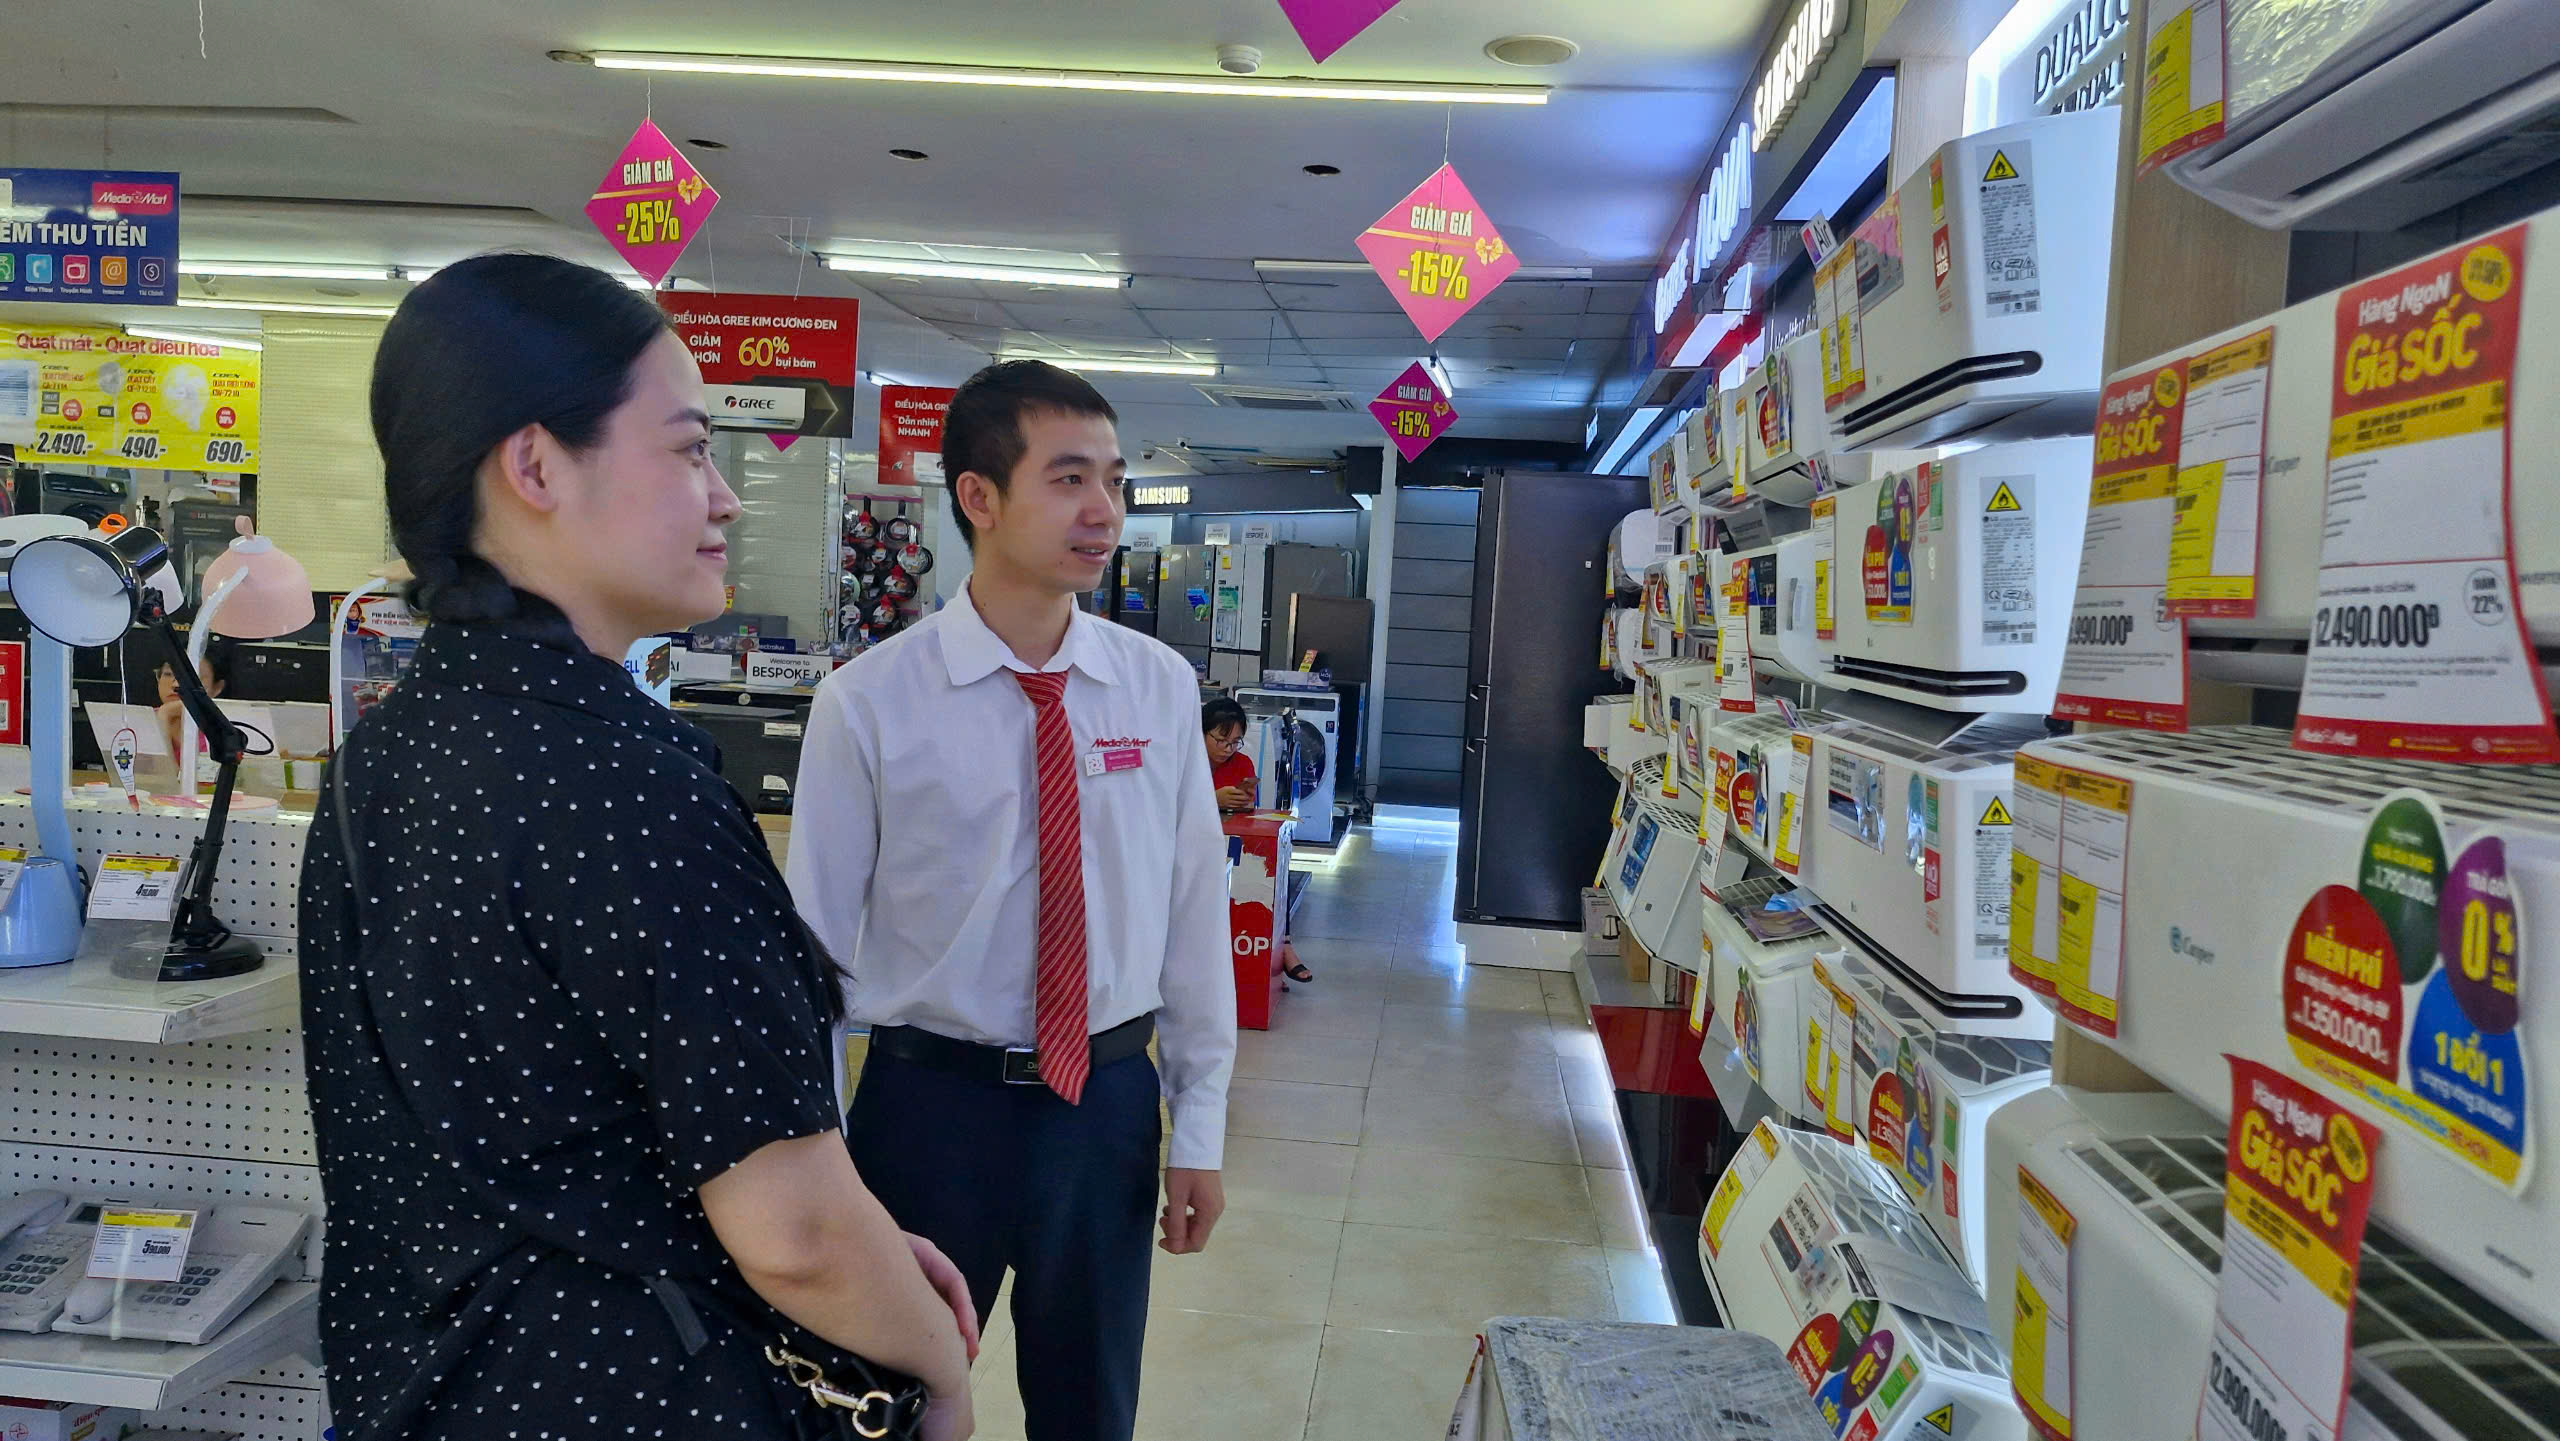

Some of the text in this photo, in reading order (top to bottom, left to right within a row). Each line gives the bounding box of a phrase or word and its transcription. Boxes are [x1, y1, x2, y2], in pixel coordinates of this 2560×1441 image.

[623, 156, 674, 185] GIẢM GIÁ
[616, 200, 680, 244] -25%
[1411, 202, 1472, 237] GIẢM GIÁ
[36, 222, 88, 246] THU
[91, 218, 148, 247] TIỀN
[1397, 250, 1469, 300] -15%
[673, 310, 837, 330] ĐIỀU HÒA GREE KIM CƯƠNG ĐEN
[689, 331, 721, 348] GIẢM
[738, 336, 790, 367] 60%
[775, 356, 816, 369] bụi bám
[2344, 333, 2398, 396] Giá
[739, 398, 776, 410] GREE
[1397, 382, 1432, 402] GIẢM GIÁ
[898, 428, 931, 438] NHANH
[1391, 410, 1430, 438] -15%
[121, 436, 167, 459] 490.-
[206, 440, 252, 464] 690.-
[1133, 486, 1190, 505] SAMSUNG
[2472, 595, 2503, 614] 22%
[752, 666, 810, 680] BESPOKE
[769, 657, 810, 666] Welcome to
[1233, 930, 1269, 956] ÓP
[2435, 1031, 2448, 1066] 1
[2490, 1059, 2503, 1096] 1
[2240, 1109, 2284, 1188] Giá
